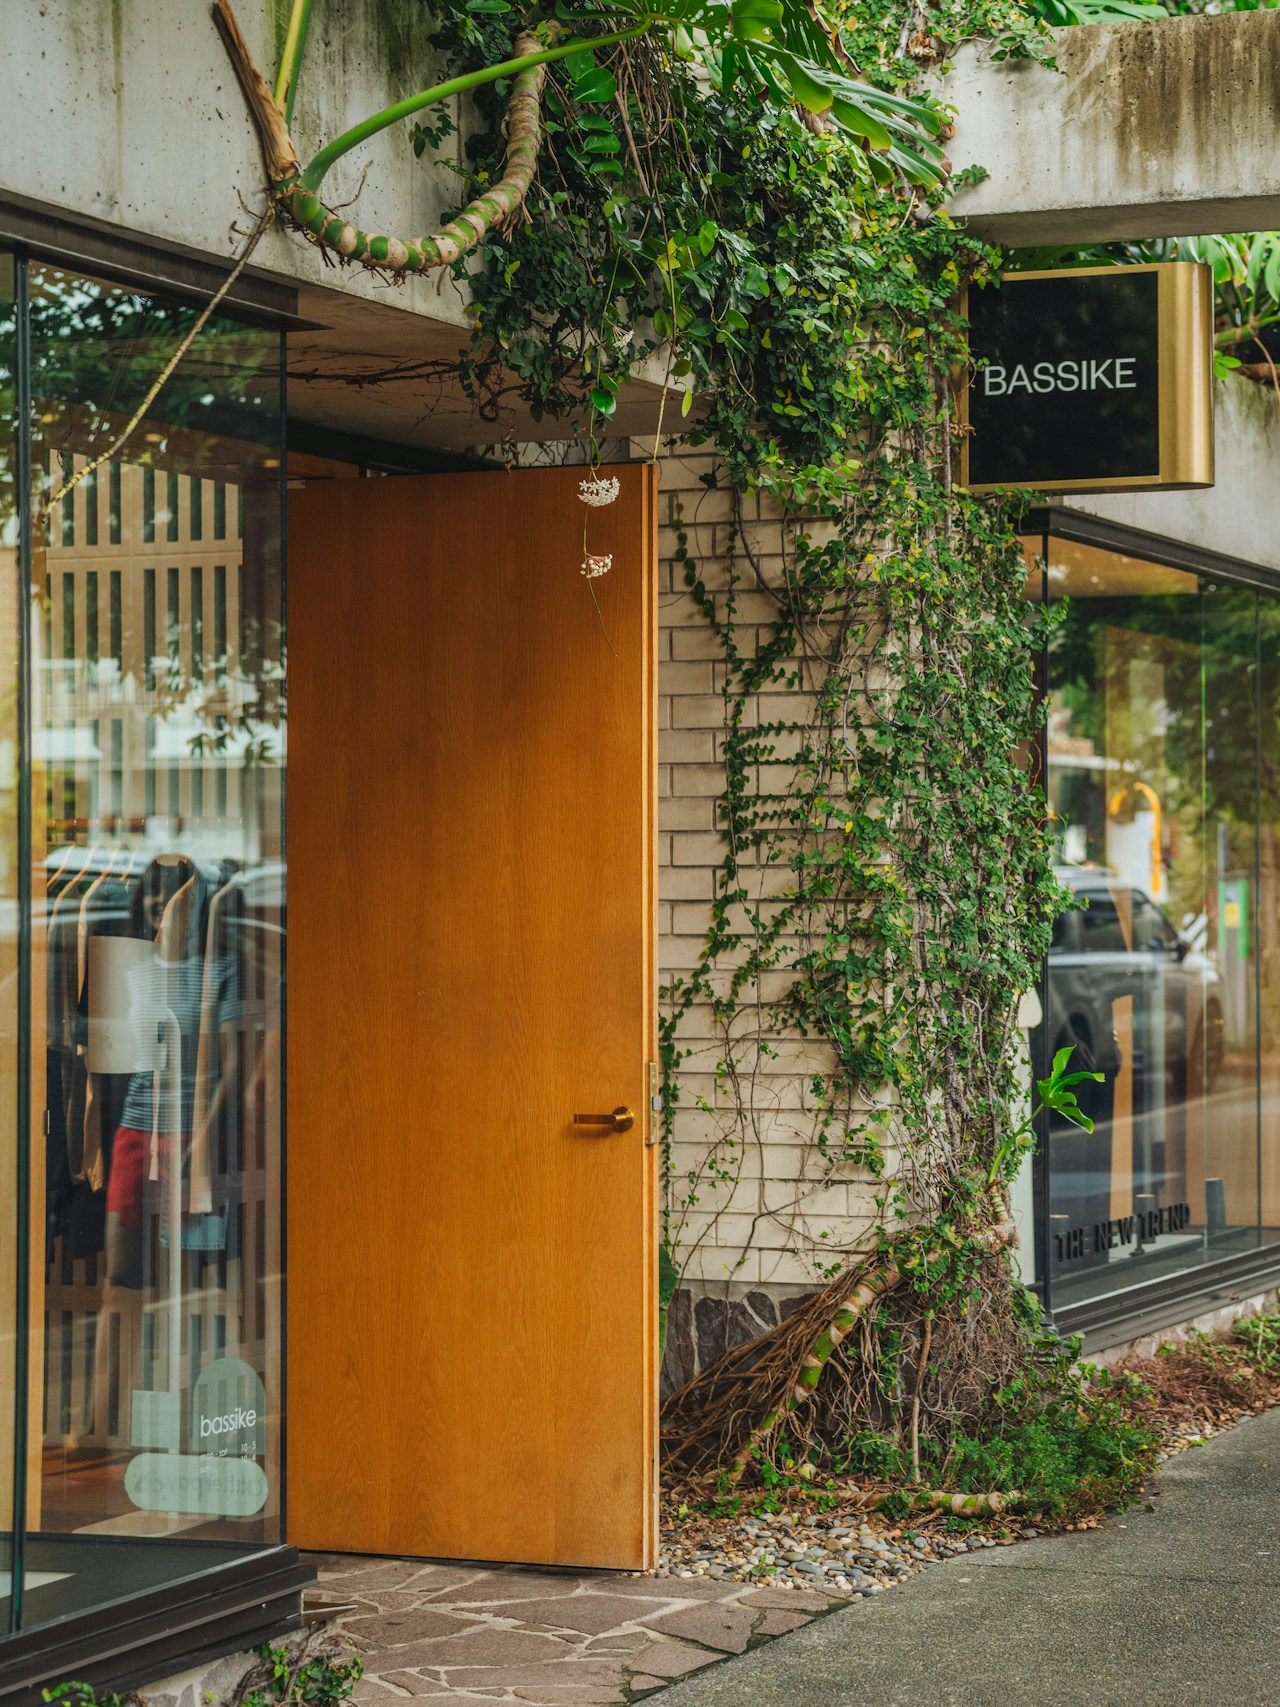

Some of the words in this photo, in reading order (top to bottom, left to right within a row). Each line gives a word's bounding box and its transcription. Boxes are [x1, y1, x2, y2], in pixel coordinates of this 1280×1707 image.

[984, 357, 1137, 396] BASSIKE
[1054, 1228, 1091, 1262] THE
[1094, 1216, 1134, 1252] NEW
[1136, 1202, 1190, 1240] TREND
[200, 1407, 257, 1437] bassike
